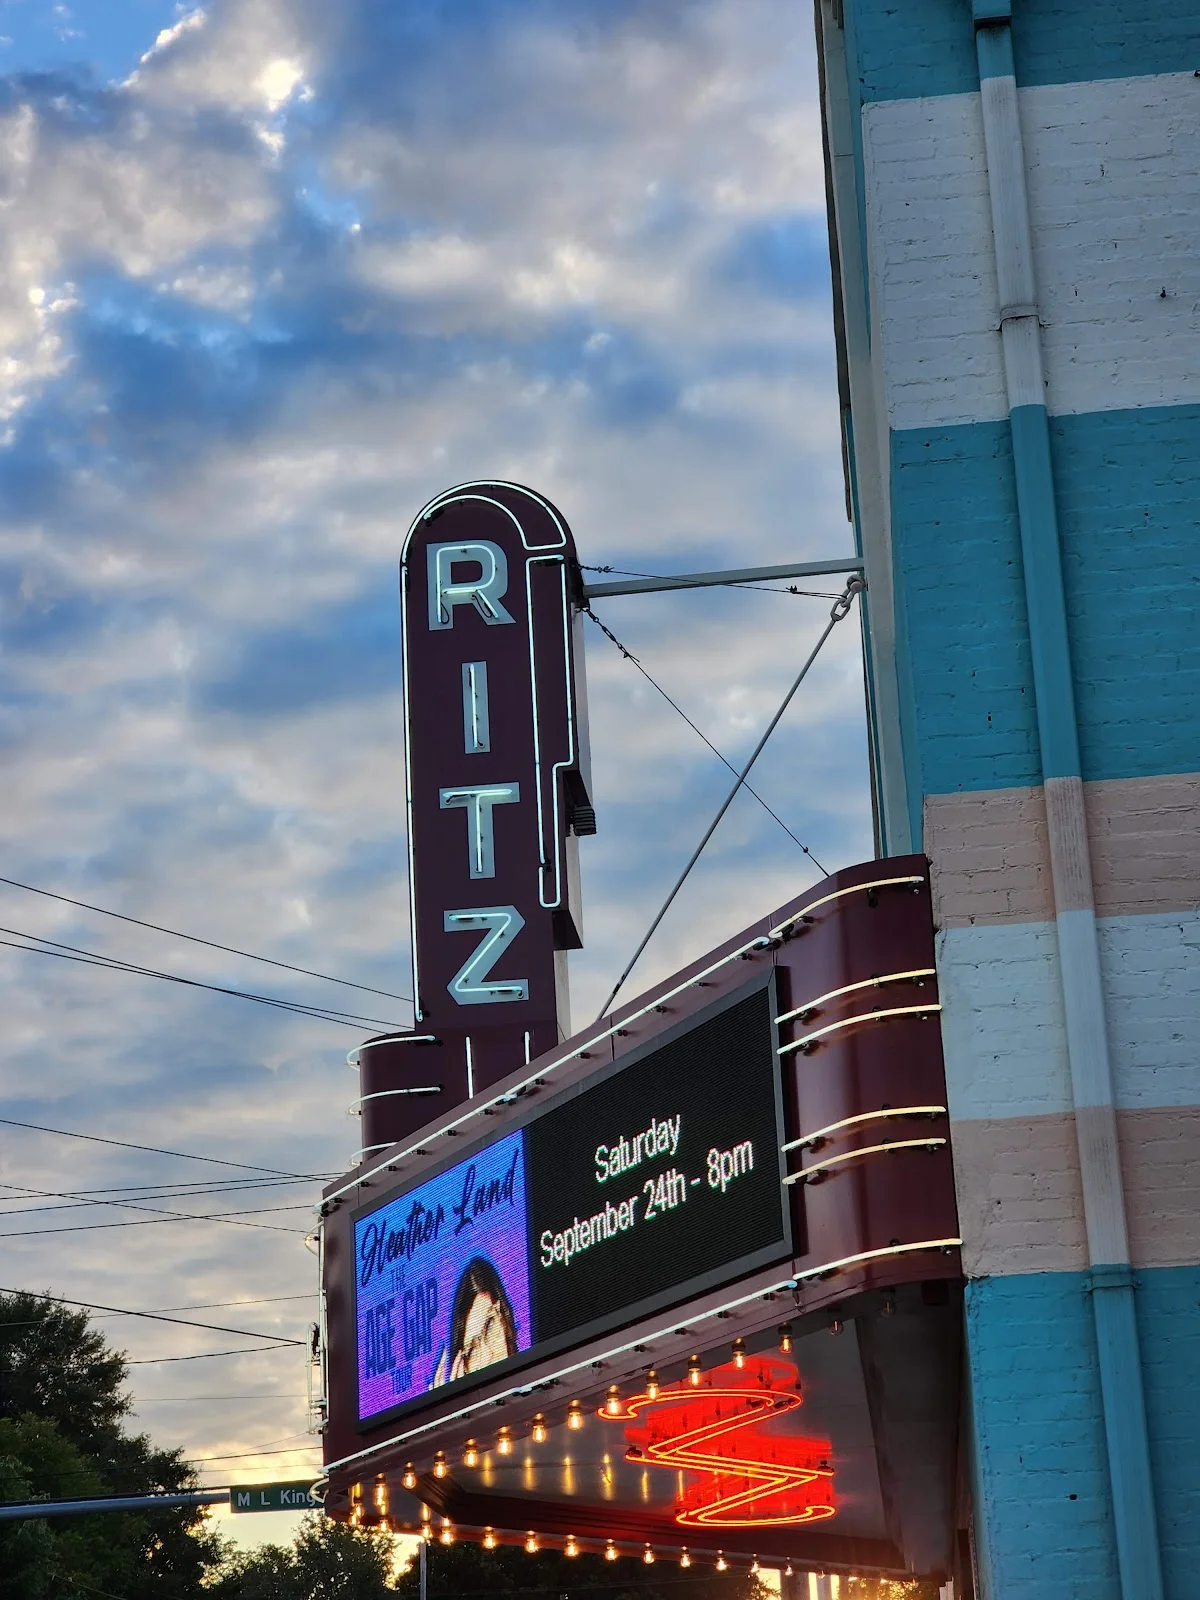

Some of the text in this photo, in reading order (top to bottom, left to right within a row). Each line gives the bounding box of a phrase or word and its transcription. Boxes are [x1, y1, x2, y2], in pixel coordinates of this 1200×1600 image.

[426, 538, 530, 1006] RITZ
[540, 1140, 754, 1268] September 24th - 8pm
[594, 1113, 681, 1183] Saturday
[360, 1148, 520, 1288] Heather Land
[365, 1276, 439, 1380] AGE GAP
[237, 1489, 317, 1507] M L King
